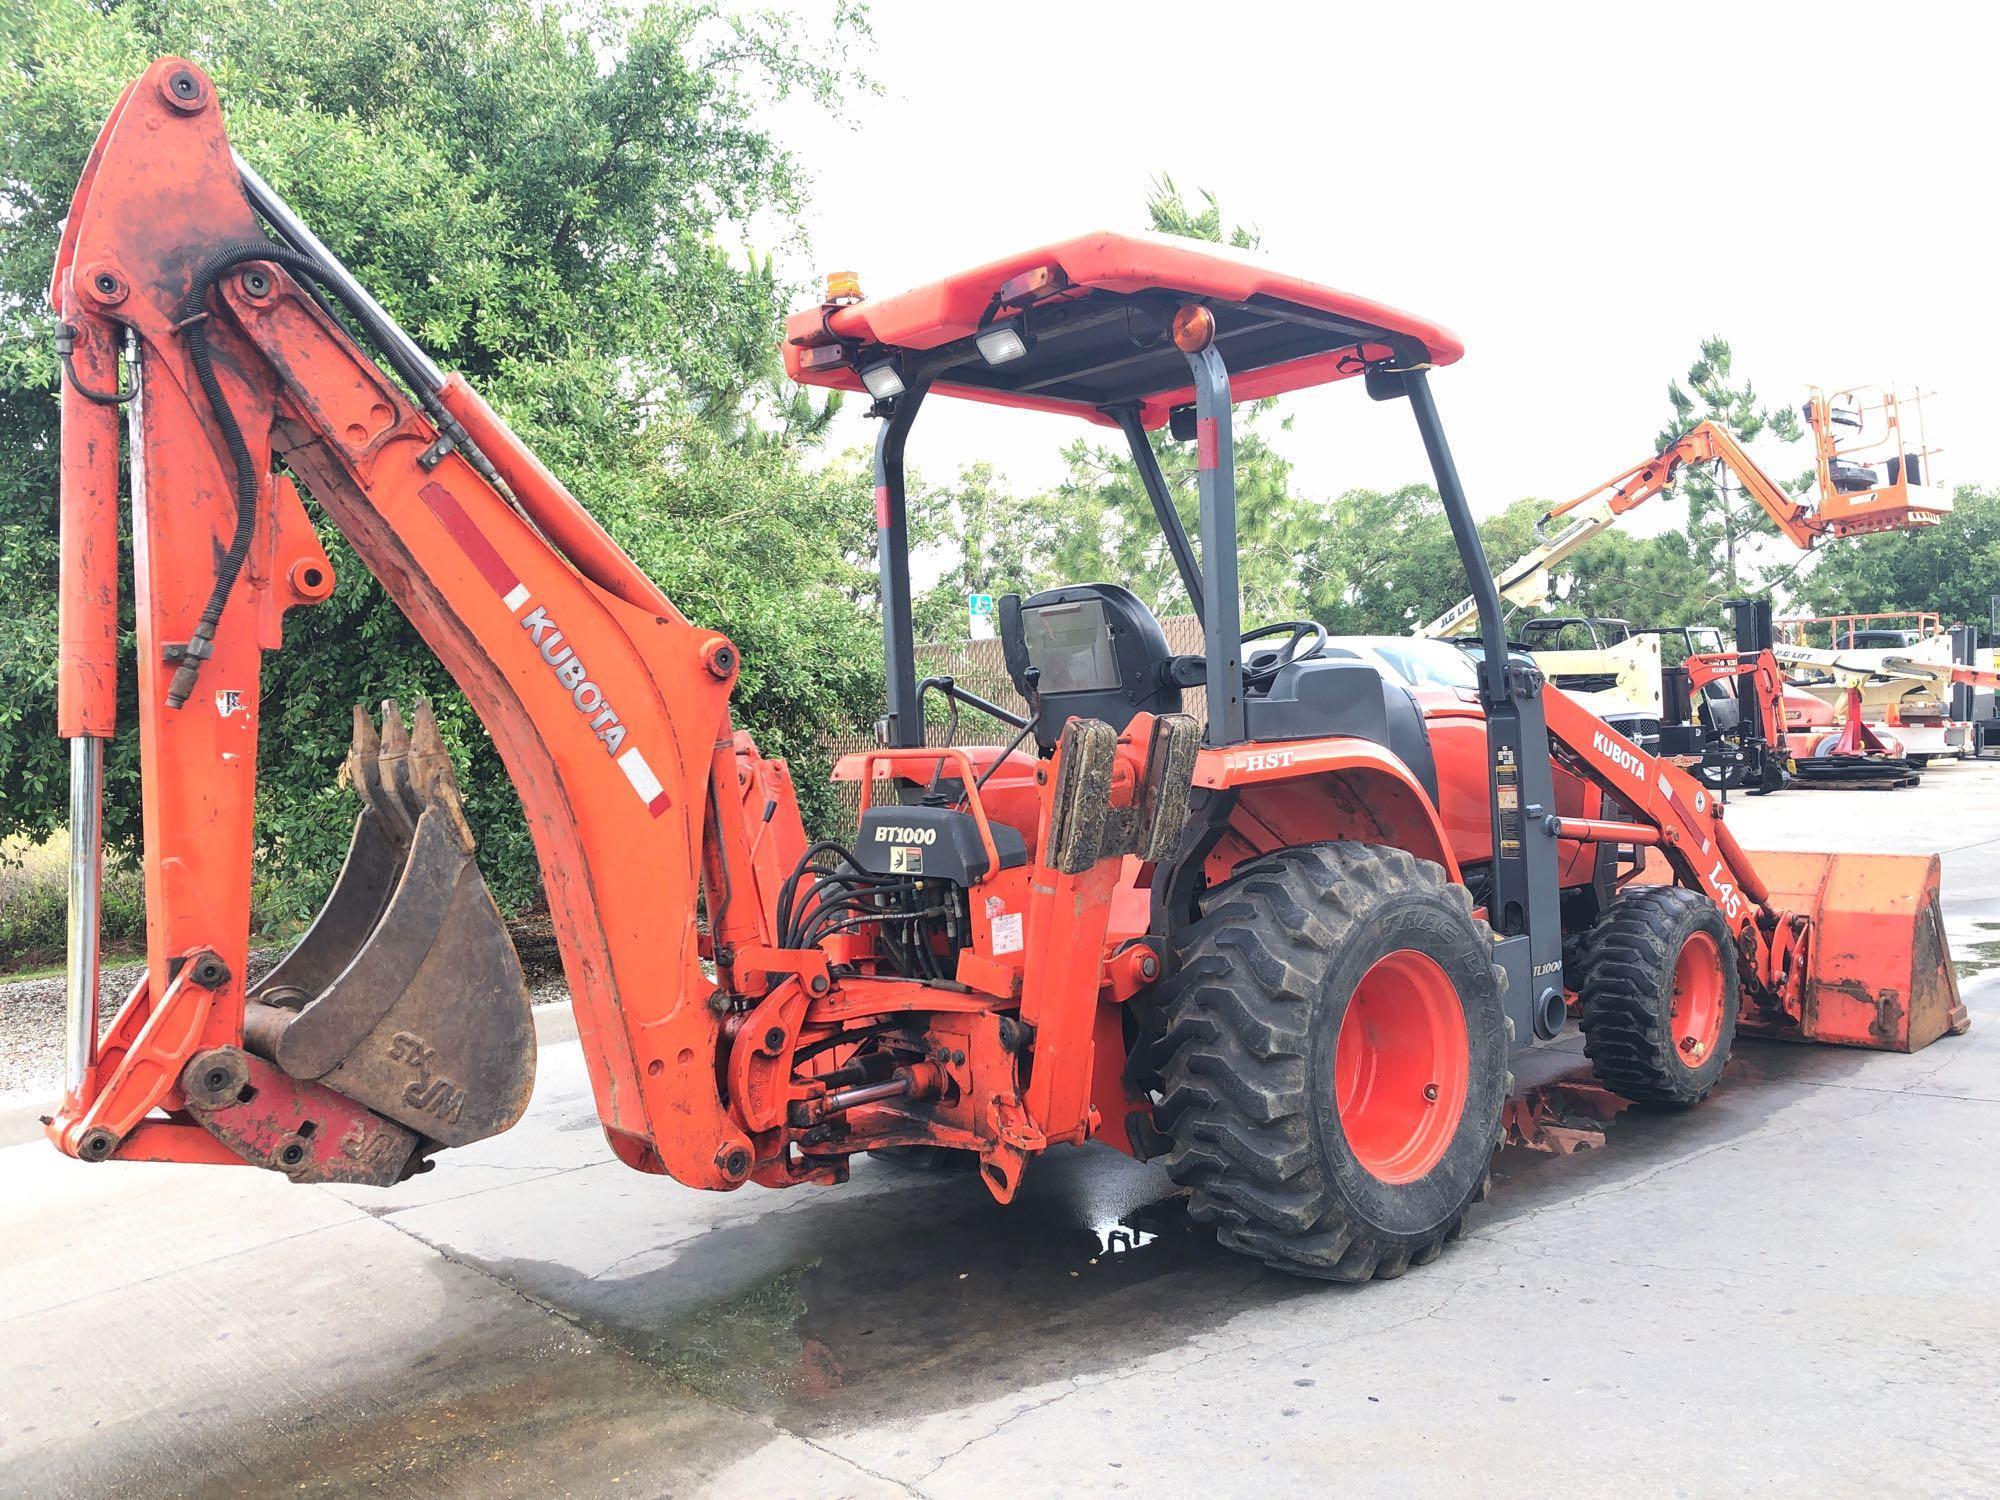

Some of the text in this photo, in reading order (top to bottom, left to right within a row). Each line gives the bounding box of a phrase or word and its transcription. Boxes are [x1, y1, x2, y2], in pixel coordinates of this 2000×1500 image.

[1441, 599, 1475, 628] JLG LIFT
[520, 605, 628, 757] KUBOTA
[1246, 751, 1294, 771] HST
[1593, 730, 1645, 781] KUBOTA
[875, 826, 937, 845] BT1000
[1708, 861, 1741, 918] L45
[1384, 910, 1460, 944] TRAC
[1533, 960, 1562, 976] TL1000
[402, 1064, 467, 1125] WR
